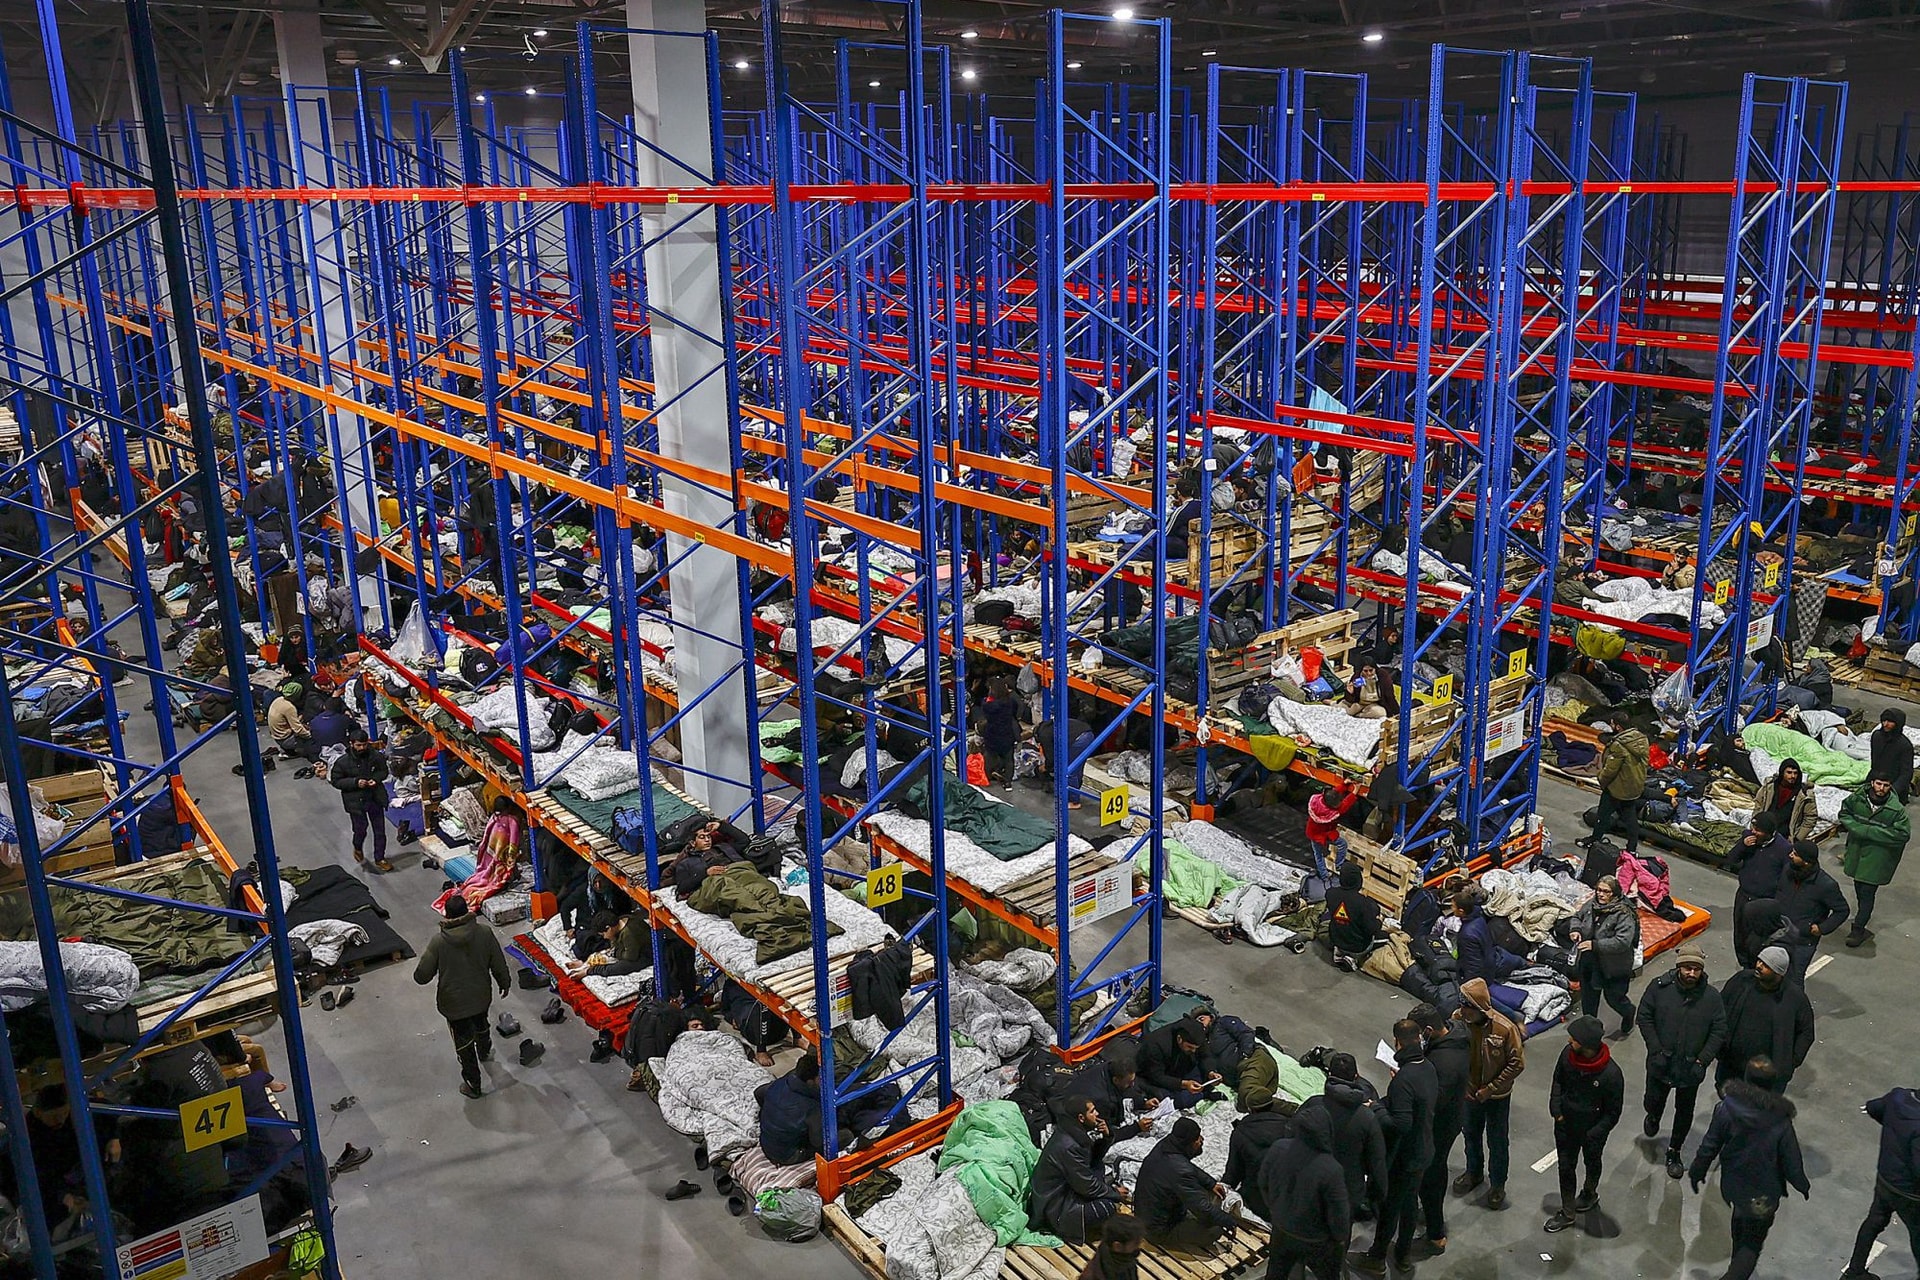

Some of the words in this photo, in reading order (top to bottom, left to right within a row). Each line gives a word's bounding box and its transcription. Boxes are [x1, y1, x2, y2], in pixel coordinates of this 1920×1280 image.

[1767, 569, 1775, 581] 53
[1717, 586, 1726, 599] 52
[1512, 656, 1522, 672] 51
[1436, 682, 1448, 699] 50
[1106, 795, 1123, 815] 49
[873, 874, 896, 897] 48
[194, 1101, 231, 1135] 47
